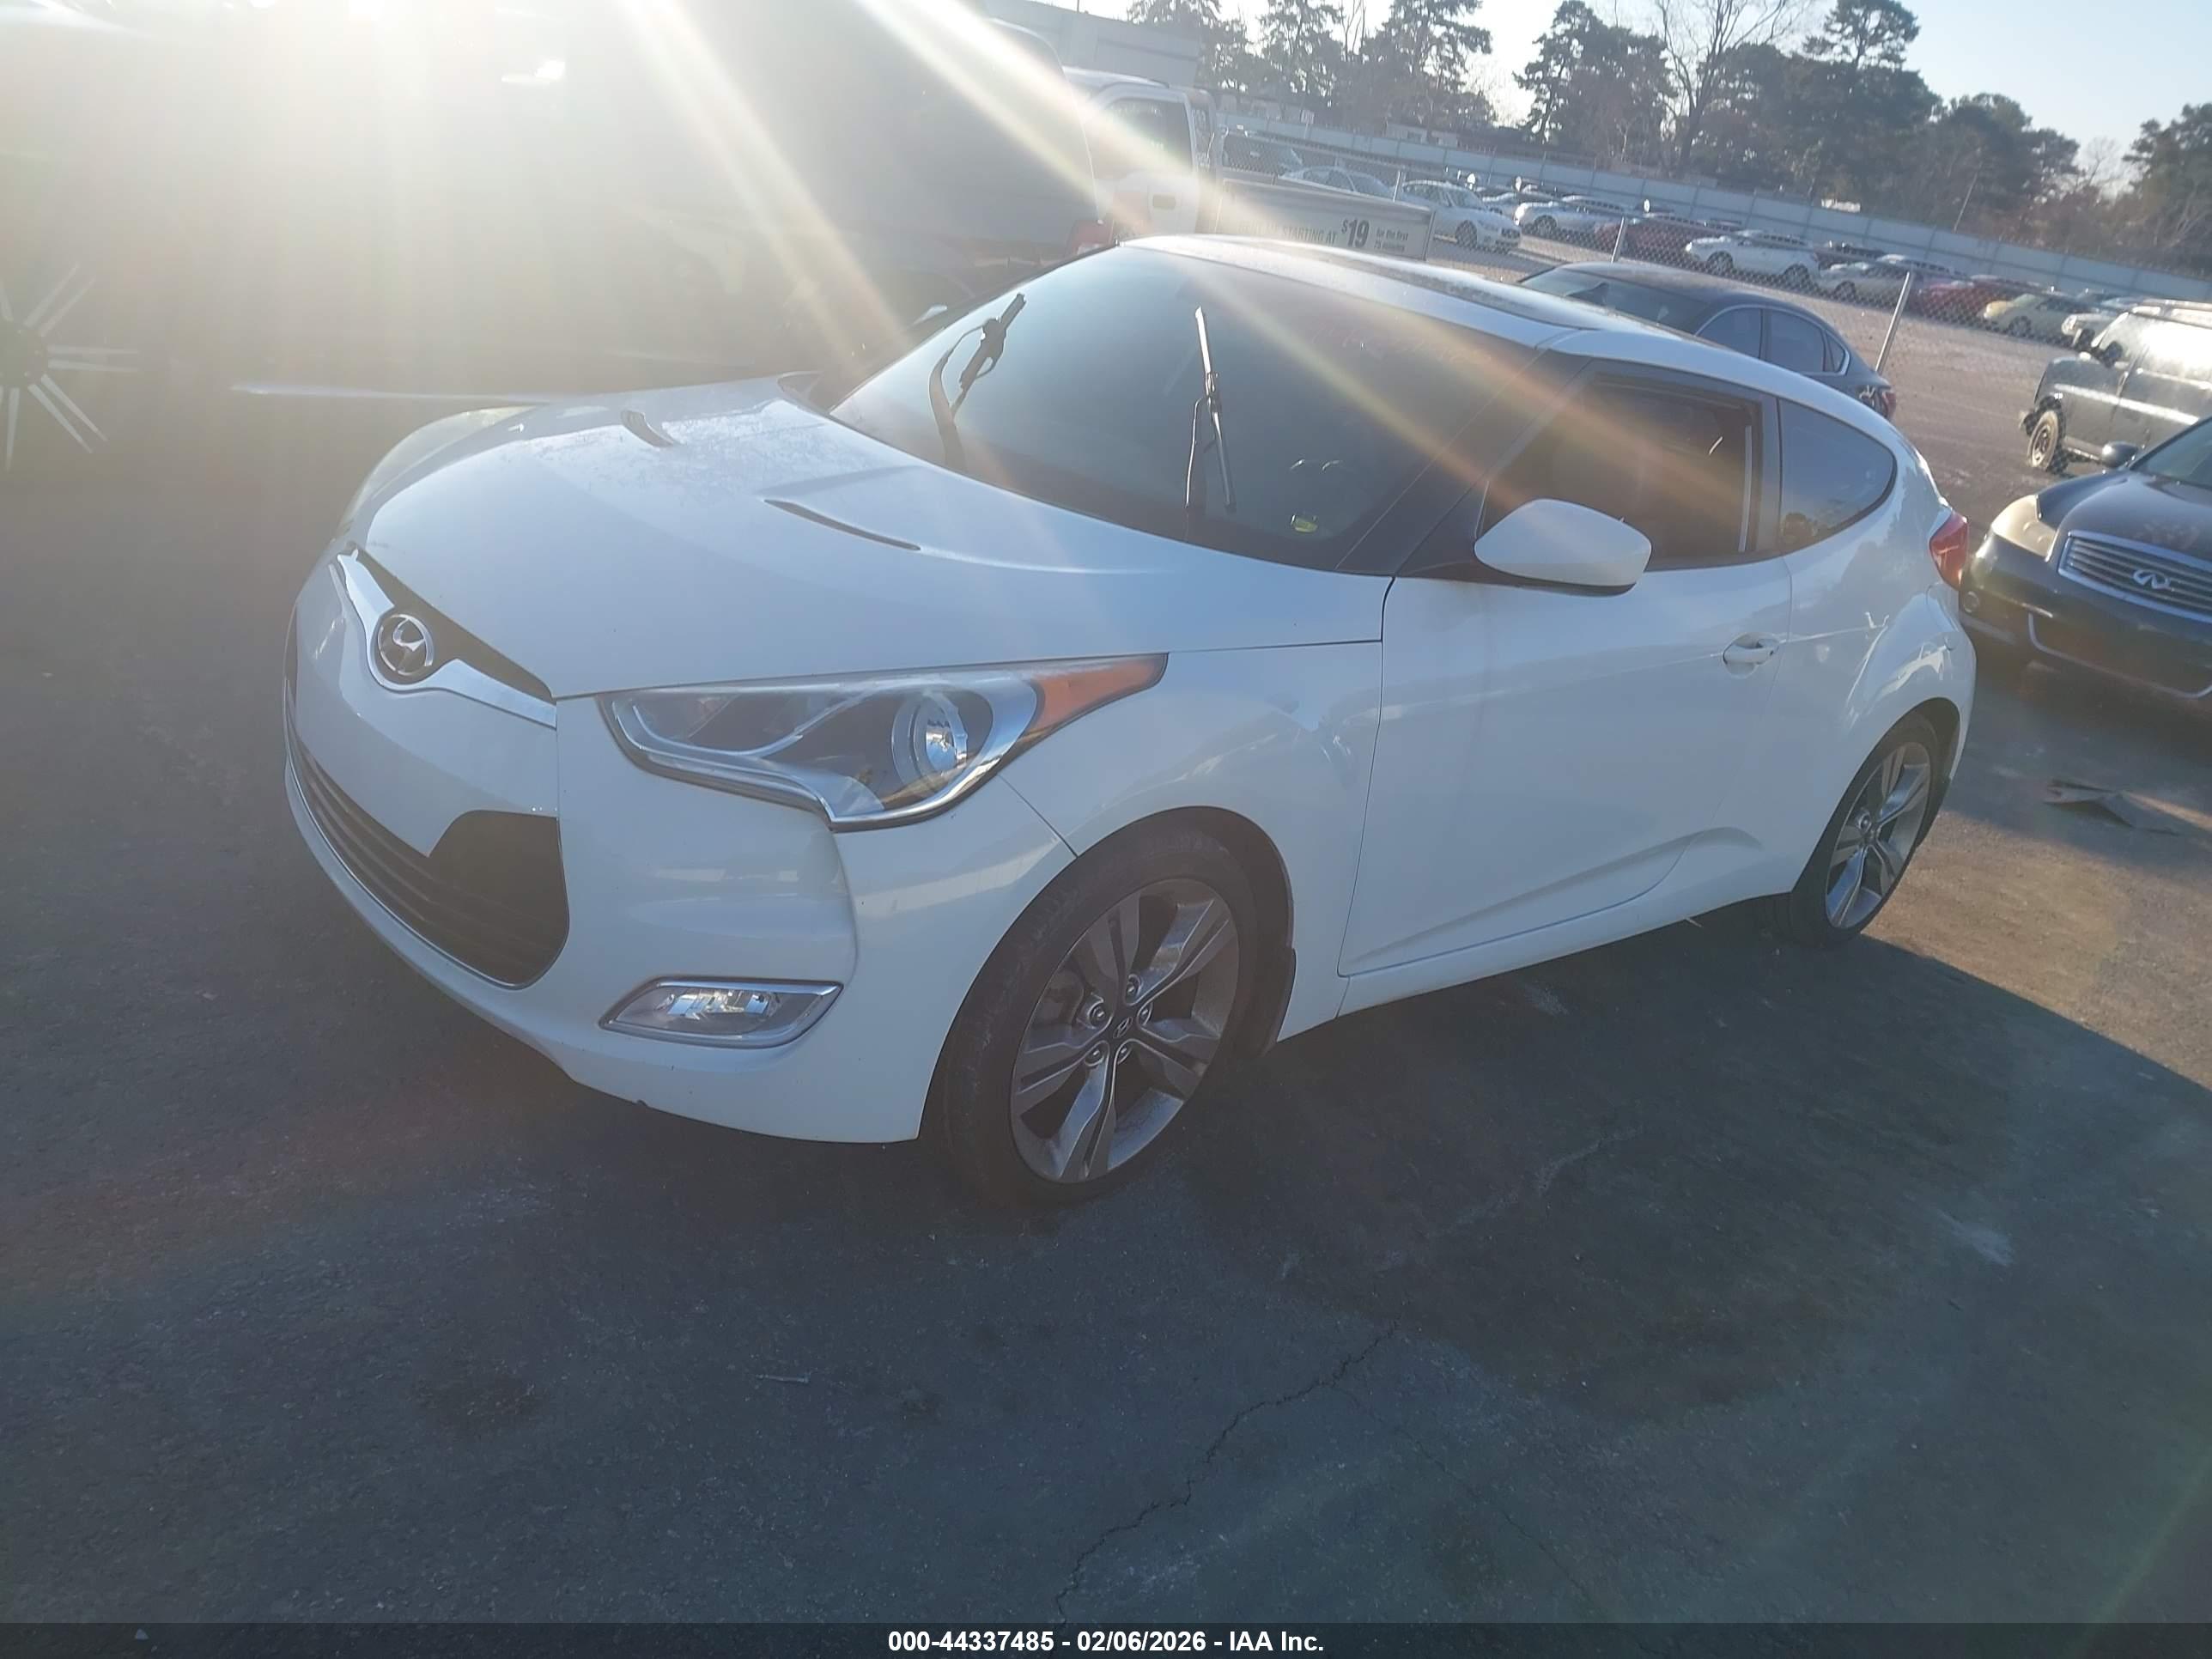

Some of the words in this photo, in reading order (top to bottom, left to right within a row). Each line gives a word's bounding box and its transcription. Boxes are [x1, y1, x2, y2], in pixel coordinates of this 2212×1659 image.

[1282, 226, 1324, 242] STARTING
[1325, 229, 1337, 245] AT
[1340, 217, 1370, 249] $19
